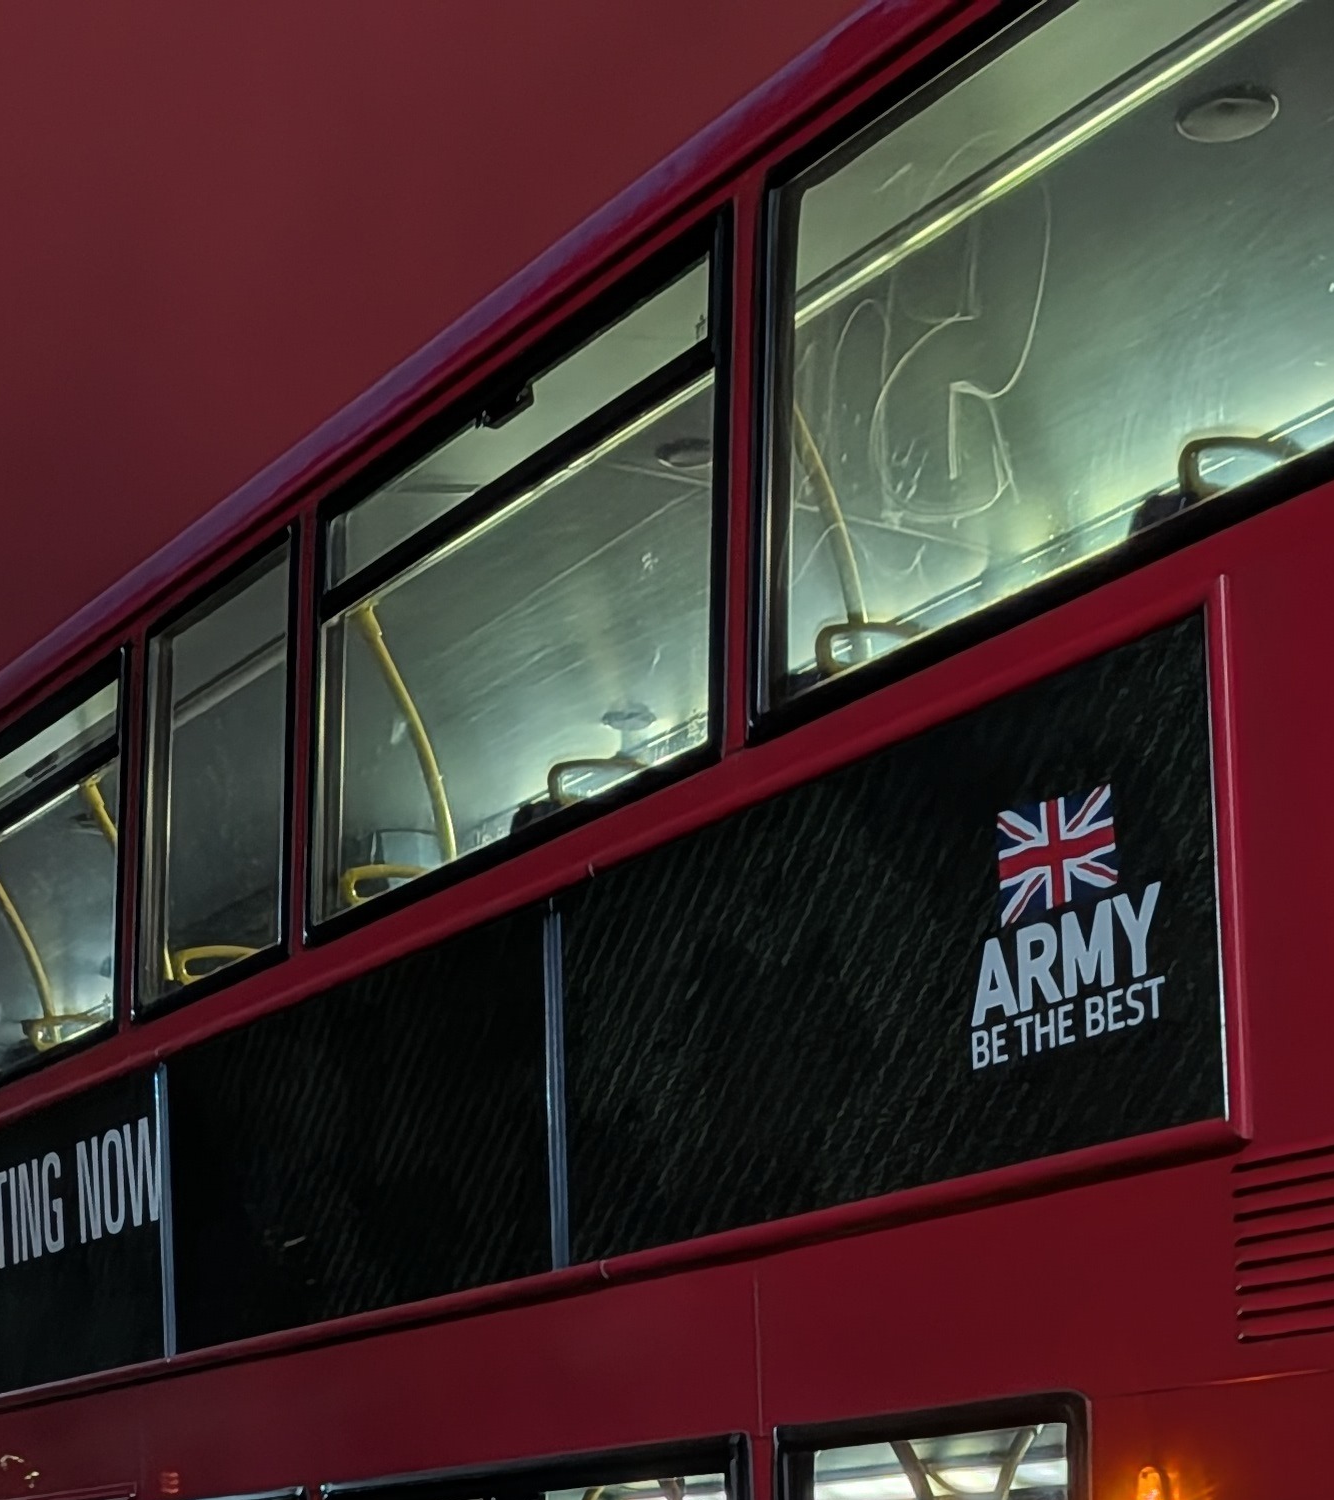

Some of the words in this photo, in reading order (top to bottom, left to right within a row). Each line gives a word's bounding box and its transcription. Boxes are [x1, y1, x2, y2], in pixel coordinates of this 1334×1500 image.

[971, 881, 1161, 1027] ARMY
[971, 1023, 1009, 1070] BE
[1014, 1003, 1076, 1057] THE
[1084, 975, 1166, 1038] BEST
[75, 1116, 162, 1245] NOW
